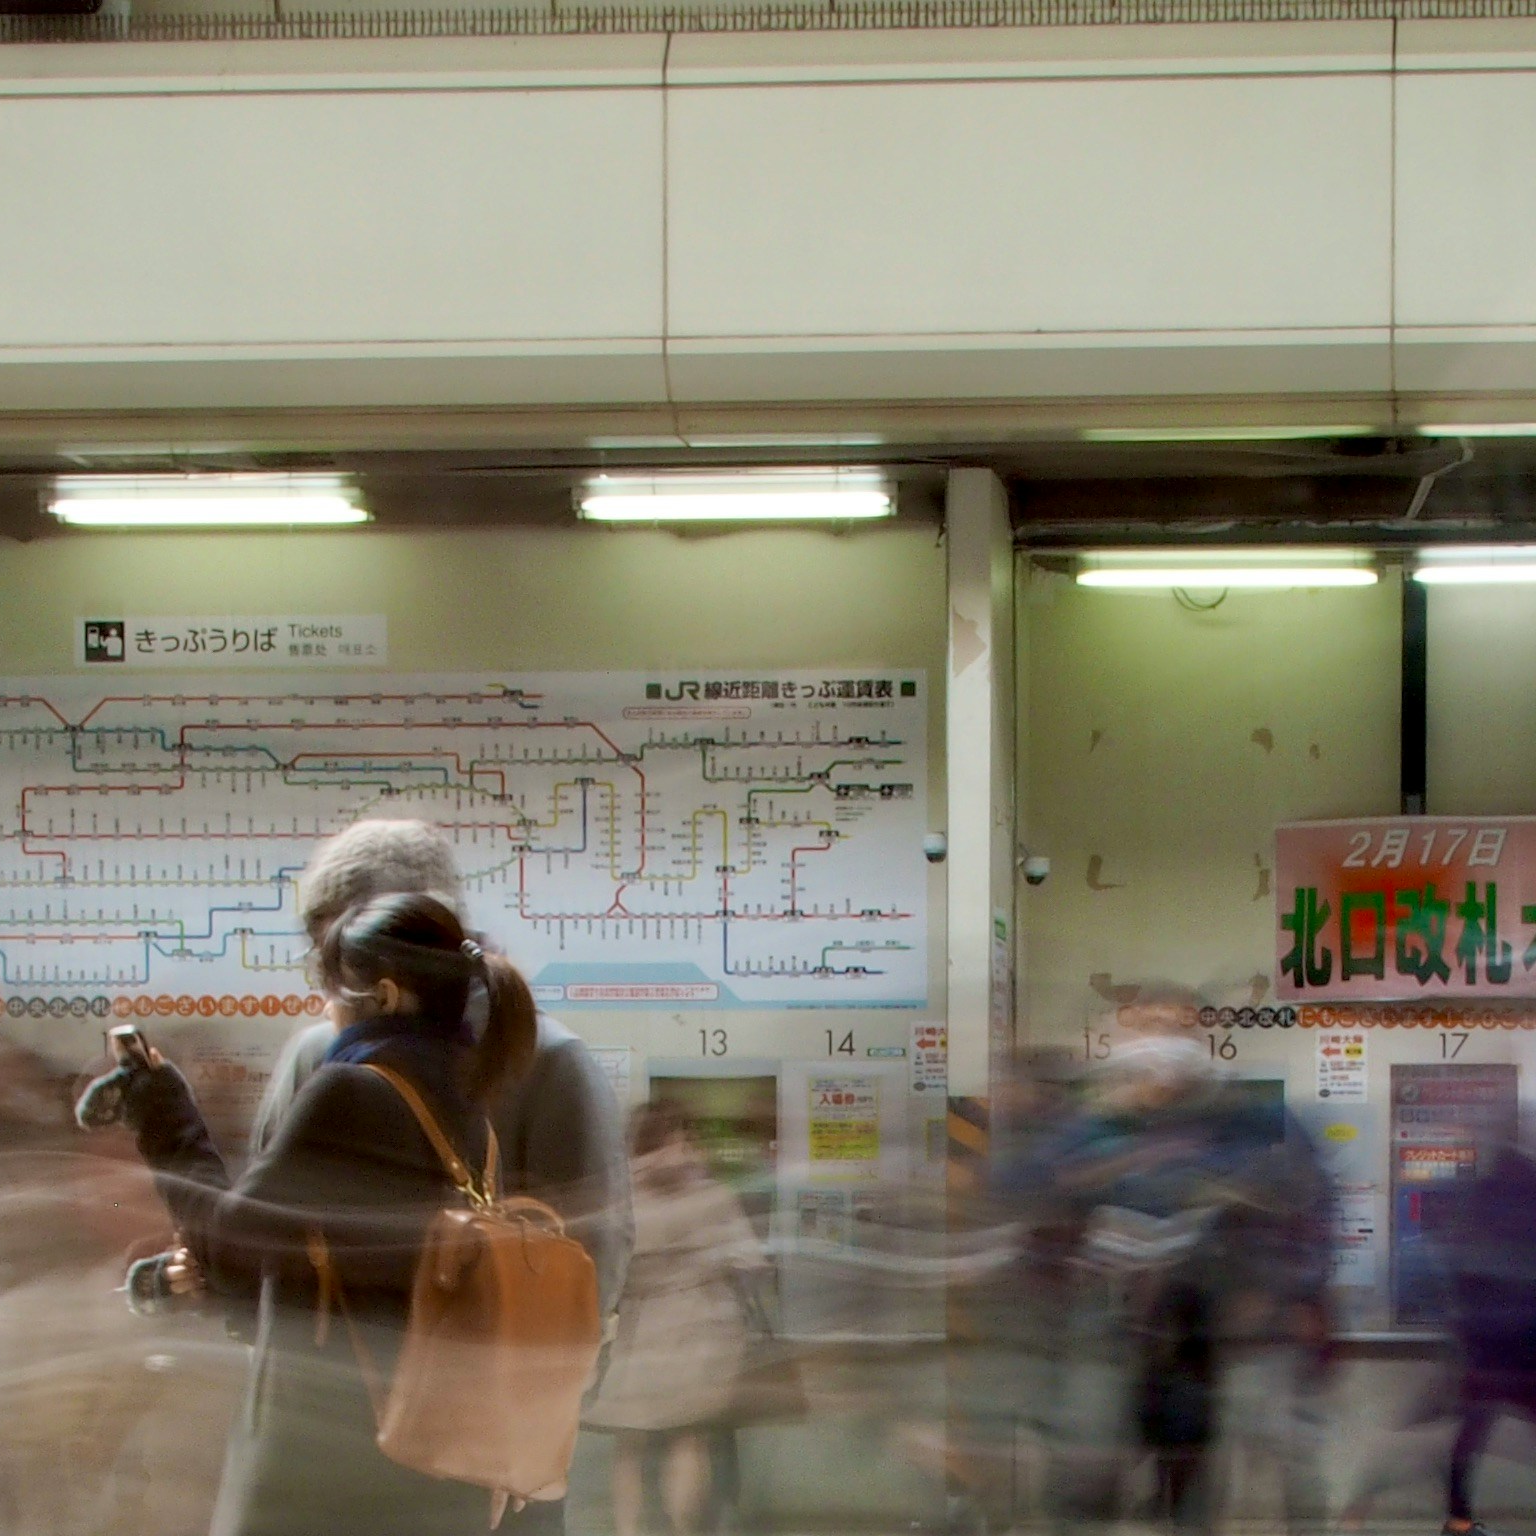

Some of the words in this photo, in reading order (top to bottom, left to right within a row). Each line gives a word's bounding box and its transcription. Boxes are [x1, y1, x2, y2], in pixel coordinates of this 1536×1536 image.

[134, 626, 279, 654] きっぷうりば
[289, 622, 344, 639] Tickets
[1342, 827, 1508, 868] 2月17日
[697, 1028, 728, 1056] 13
[825, 1029, 856, 1056] 14
[1084, 1033, 1112, 1060] 15
[1207, 1034, 1238, 1060] 16
[1439, 1032, 1470, 1059] 17
